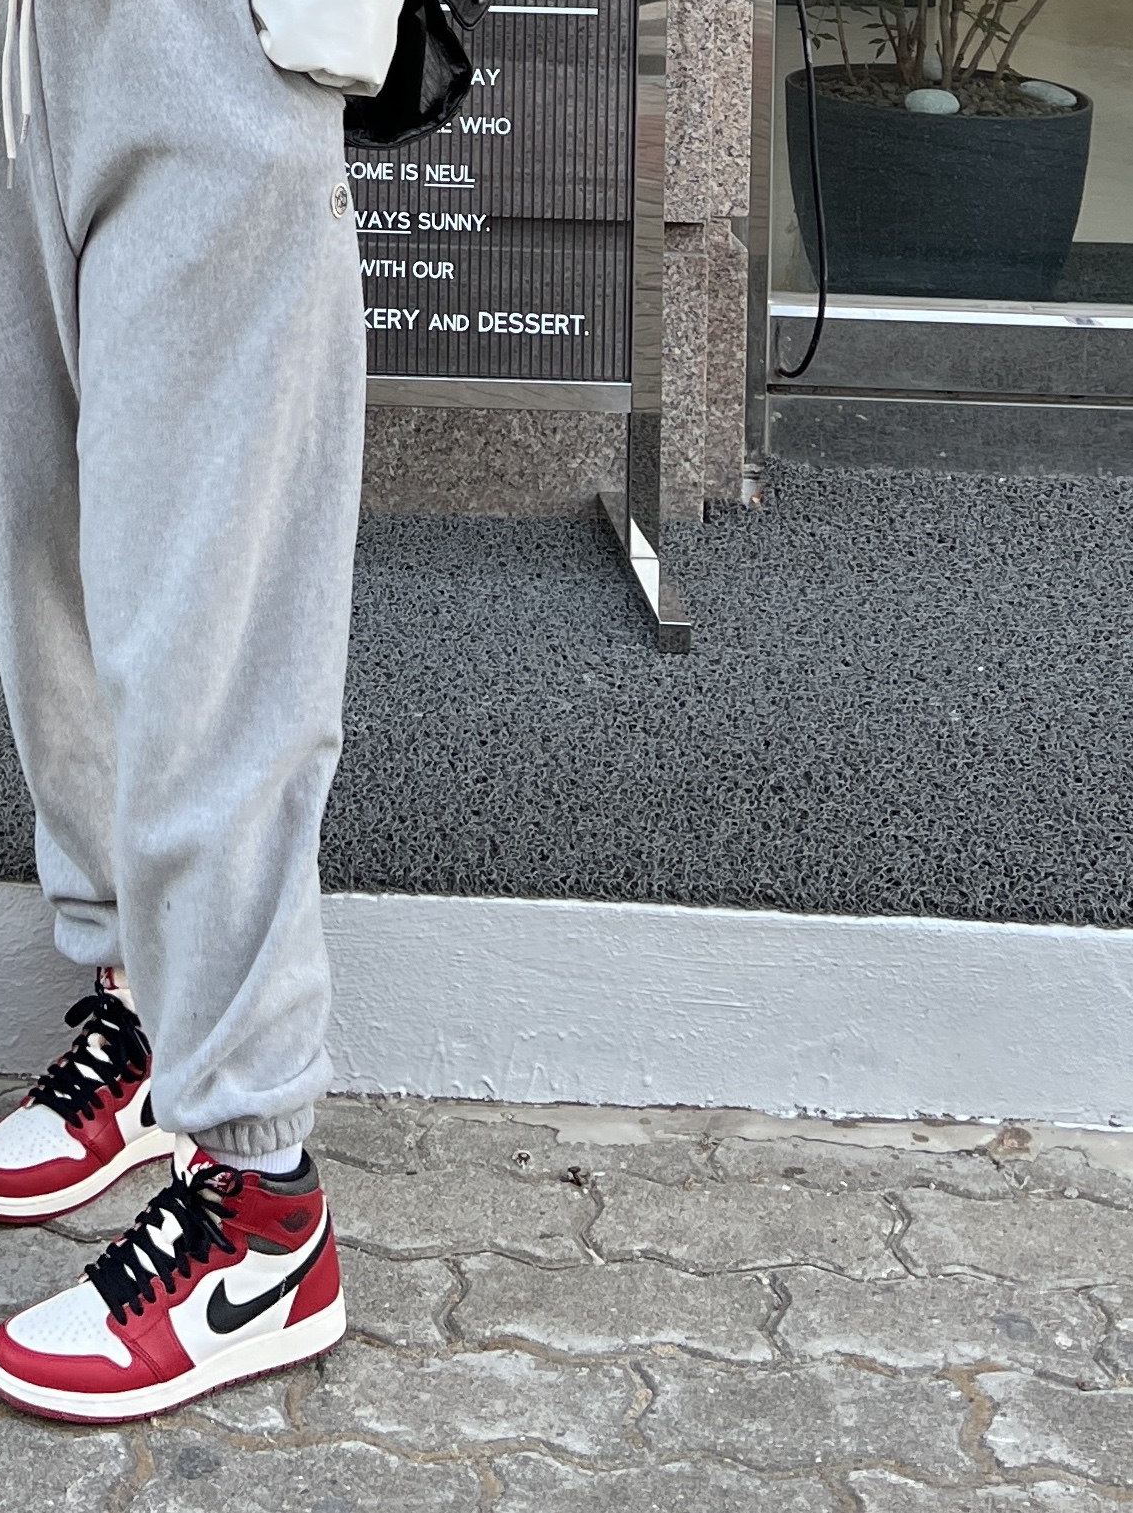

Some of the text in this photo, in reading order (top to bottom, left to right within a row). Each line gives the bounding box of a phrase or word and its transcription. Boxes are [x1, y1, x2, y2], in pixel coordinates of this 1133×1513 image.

[459, 116, 511, 135] WHO
[401, 163, 419, 181] IS
[426, 165, 475, 183] NEUL
[418, 212, 490, 232] SUNNY.
[360, 259, 454, 279] WITH OUR
[429, 314, 470, 332] AND
[478, 311, 589, 336] DESSERT.
